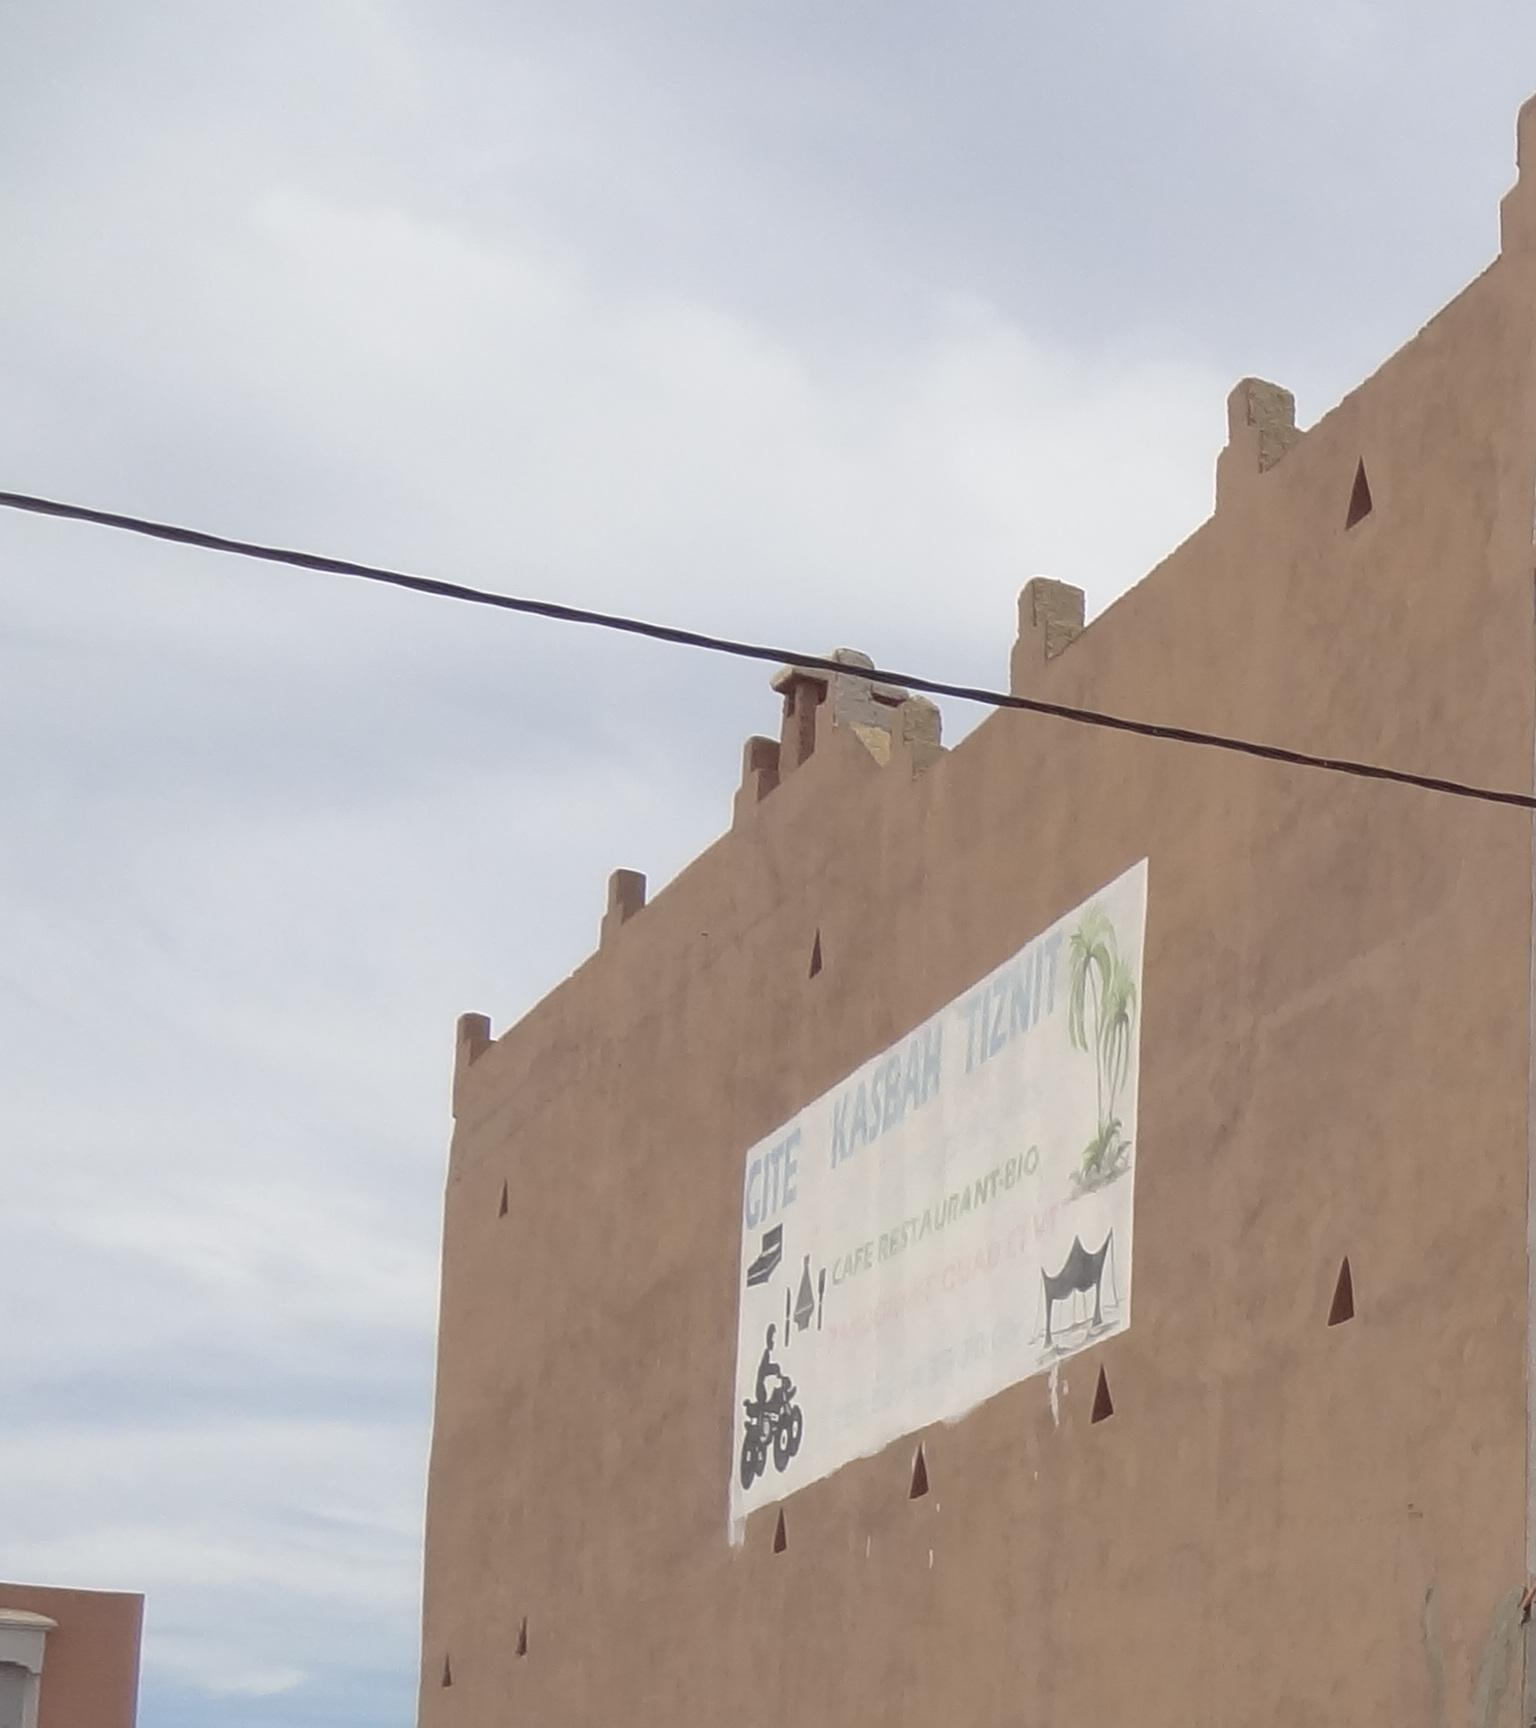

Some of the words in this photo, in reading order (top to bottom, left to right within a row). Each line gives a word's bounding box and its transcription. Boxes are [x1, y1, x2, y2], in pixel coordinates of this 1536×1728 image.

[745, 1127, 801, 1230] GITE
[830, 1021, 942, 1170] KASBAH
[956, 928, 1063, 1075] TIZNIT
[832, 1241, 874, 1285] CAFE
